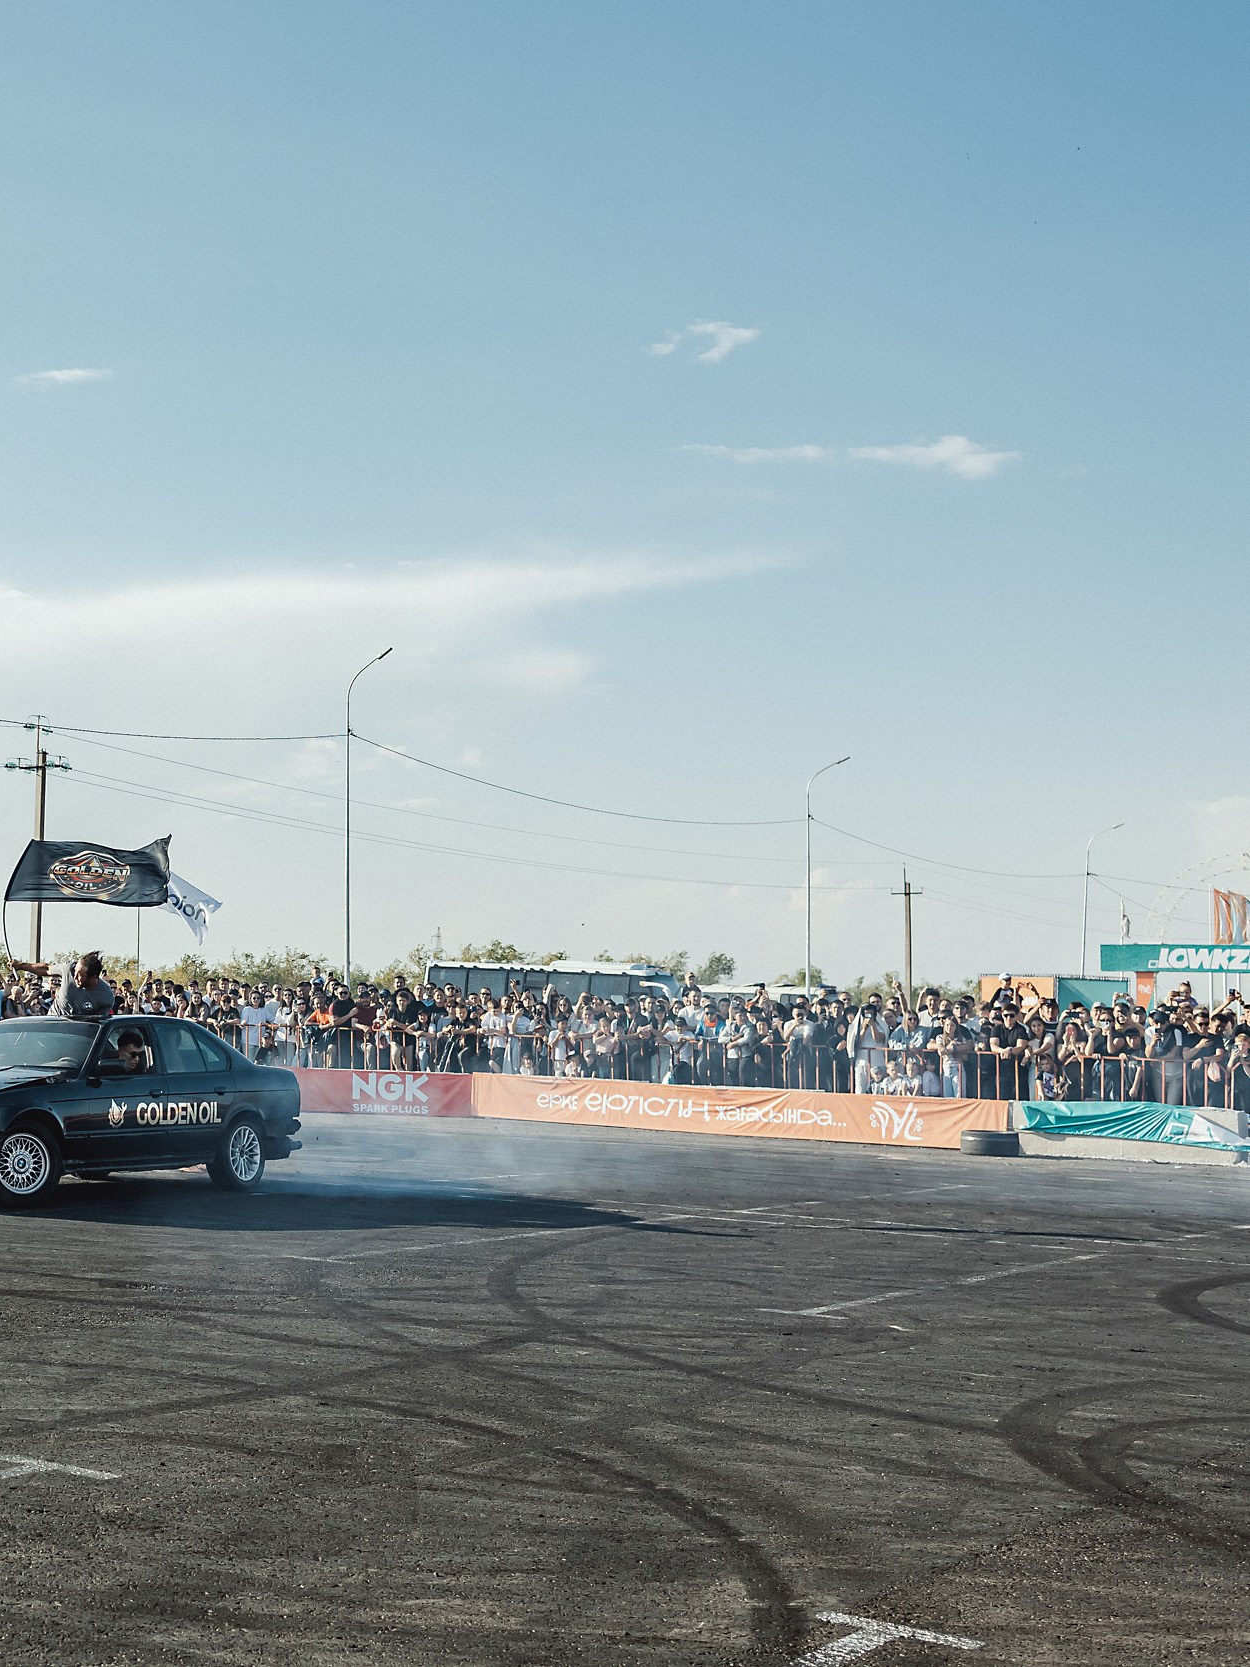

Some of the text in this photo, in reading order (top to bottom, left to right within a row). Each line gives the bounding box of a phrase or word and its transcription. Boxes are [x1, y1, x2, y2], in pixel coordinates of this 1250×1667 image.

[53, 865, 128, 881] GOLDEN
[1157, 947, 1250, 970] LOWKZ
[352, 1072, 429, 1103] NGK
[136, 1101, 222, 1125] GOLDEN OIL
[352, 1103, 429, 1115] SPARK PLUGS
